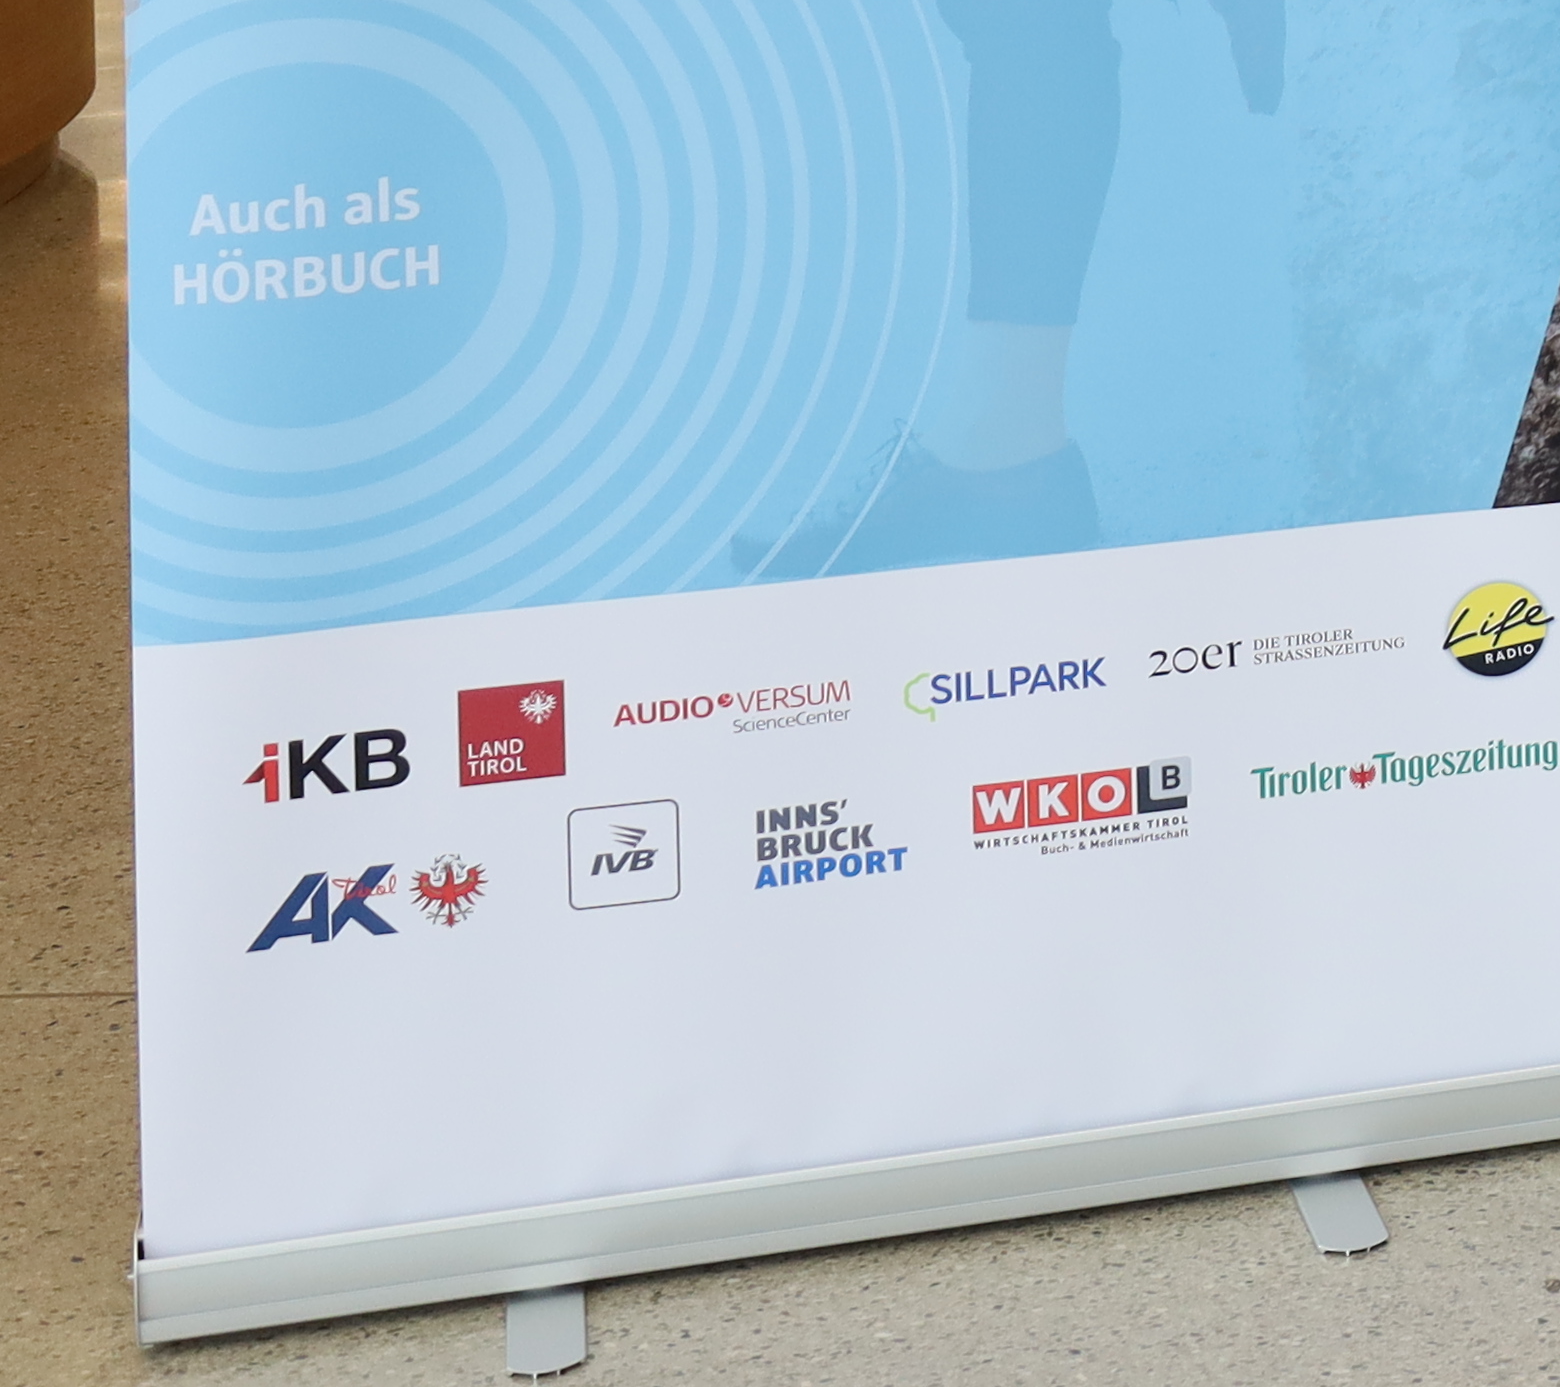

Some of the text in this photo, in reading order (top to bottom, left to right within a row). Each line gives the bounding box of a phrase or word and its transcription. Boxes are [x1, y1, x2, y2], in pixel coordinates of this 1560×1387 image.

[188, 177, 421, 237] Auch als
[171, 241, 441, 306] HÖRBUCH
[1253, 627, 1354, 651] DIE TIROLER
[1442, 597, 1555, 651] Life
[1147, 639, 1243, 679] 20er
[1252, 636, 1406, 666] STRASSENZEITUNG
[1484, 642, 1536, 665] RADIO
[930, 657, 1107, 706] SILLPARK
[466, 737, 525, 759] LAND
[466, 756, 528, 778] TIROL
[1250, 739, 1560, 800] Tiroler Tageszeitung
[756, 823, 874, 862] BRUCK
[973, 814, 1189, 851] WIRTSCHAFTSKAMMER TIROL
[1040, 841, 1076, 856] Buch-
[1089, 828, 1190, 852] Medienwirtschaft
[590, 847, 659, 877] IVB
[755, 846, 908, 890] AIRPORT
[246, 862, 400, 953] AK
